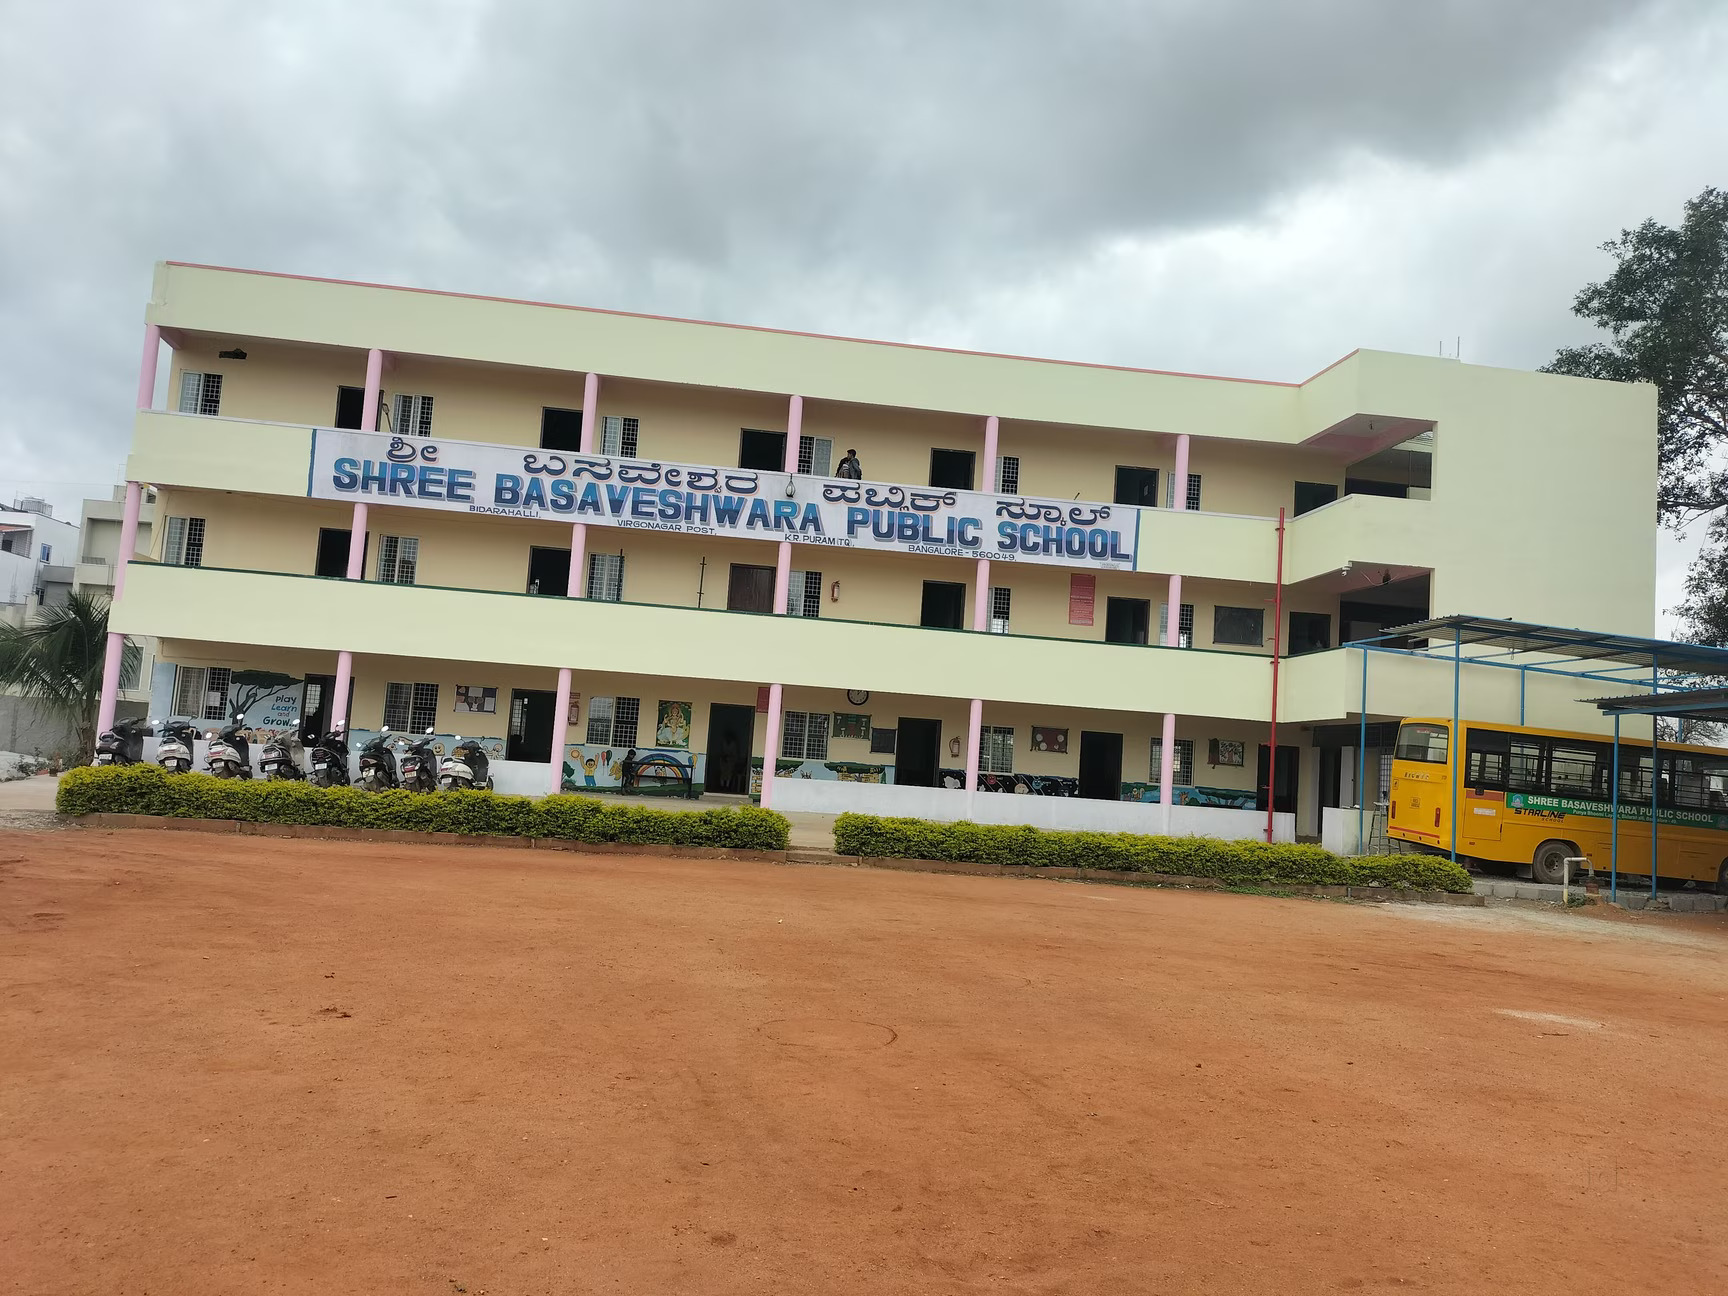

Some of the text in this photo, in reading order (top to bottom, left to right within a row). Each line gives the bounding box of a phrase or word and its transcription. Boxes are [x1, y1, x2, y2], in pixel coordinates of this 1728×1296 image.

[523, 454, 759, 495] ಬಸವೇಶ್ವರ
[822, 482, 957, 513] ಪಬ್ಲಿಕ್
[995, 498, 1111, 527] ಸ್ಕೂಲ್
[333, 457, 1132, 562] SHREE BASAVESHWARA PUBLIC SCHOOL
[617, 519, 682, 532] VIRGONAGAR
[908, 544, 963, 556] BANGALORE
[271, 703, 297, 712] Learn
[1514, 808, 1567, 820] STARLINE
[1528, 796, 1559, 807] SHREE
[1676, 811, 1713, 823] SCHOOL
